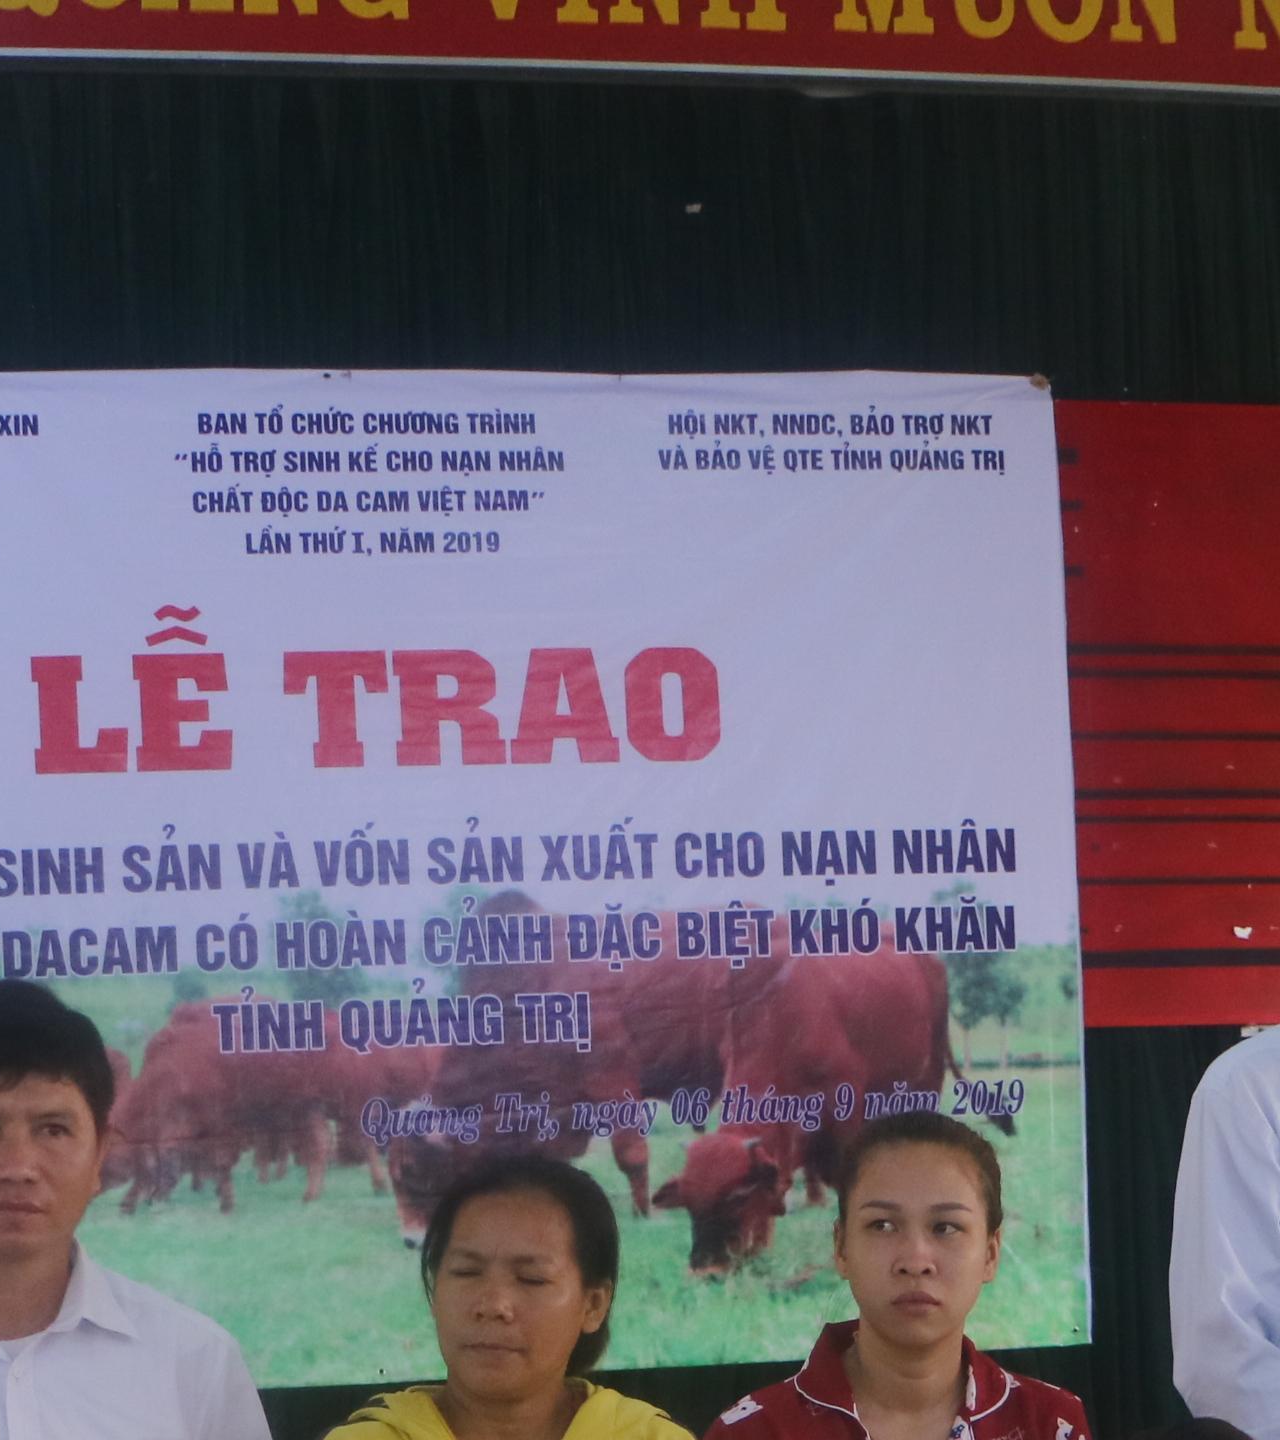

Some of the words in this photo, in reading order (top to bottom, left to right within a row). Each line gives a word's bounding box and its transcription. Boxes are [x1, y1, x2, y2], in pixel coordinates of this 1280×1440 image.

[197, 413, 247, 434] BAN
[254, 404, 283, 434] TỔ
[291, 406, 354, 434] CHỨC
[362, 411, 459, 434] CHƯƠNG
[466, 408, 535, 434] TRÌNH
[668, 414, 706, 439] HỘI
[714, 413, 764, 436] NKT,
[772, 414, 843, 437] NNDC,
[850, 405, 894, 436] BẢO
[901, 413, 944, 440] TRỢ
[950, 414, 992, 436] NKT
[230, 449, 276, 478] TRỢ
[283, 450, 340, 473] SINH
[348, 443, 378, 472] KẾ
[386, 450, 433, 472] CHO
[441, 450, 491, 476] NẠN
[499, 446, 564, 471] NHÂN
[658, 445, 688, 470] VÀ
[695, 440, 740, 470] BẢO
[748, 444, 775, 475] VỆ
[783, 449, 823, 472] QTE
[830, 441, 882, 470] TỈNH
[889, 440, 964, 472] QUẢNG
[970, 449, 1005, 475] TRỊ
[192, 483, 253, 513] CHẤT
[260, 486, 309, 517] ĐỘC
[316, 490, 349, 512] DA
[356, 490, 409, 512] CAM
[417, 486, 466, 516] VIỆT
[245, 524, 291, 554] LẦN
[298, 526, 347, 554] THỨ
[380, 527, 435, 553] NĂM
[443, 531, 499, 553] 2019
[30, 604, 233, 775] LỄ
[283, 646, 720, 768] TRAO
[122, 824, 221, 892] SẢN
[237, 831, 300, 888] VÀ
[313, 823, 410, 886] VỐN
[427, 817, 524, 884] SẢN
[542, 817, 658, 881] XUẤT
[675, 831, 765, 878] CHO
[782, 830, 877, 886] NẠN
[893, 819, 1016, 874] NHÂN
[2, 925, 178, 979] DACAM
[196, 913, 259, 972] CÓ
[275, 911, 407, 969] HOÀN
[424, 897, 552, 966] CẢNH
[567, 903, 662, 972] ĐẶC
[677, 902, 774, 969] BIỆT
[789, 900, 880, 956] KHÓ
[895, 897, 1016, 952] KHĂN
[213, 986, 325, 1054] TỈNH
[340, 978, 503, 1055] QUẢNG
[515, 992, 591, 1053] TRỊ
[361, 1095, 480, 1144] Quảng
[572, 1095, 658, 1138] ngày
[671, 1087, 711, 1126] 06
[721, 1082, 823, 1133] tháng
[834, 1082, 855, 1120] 9
[951, 1079, 1025, 1115] 2019
